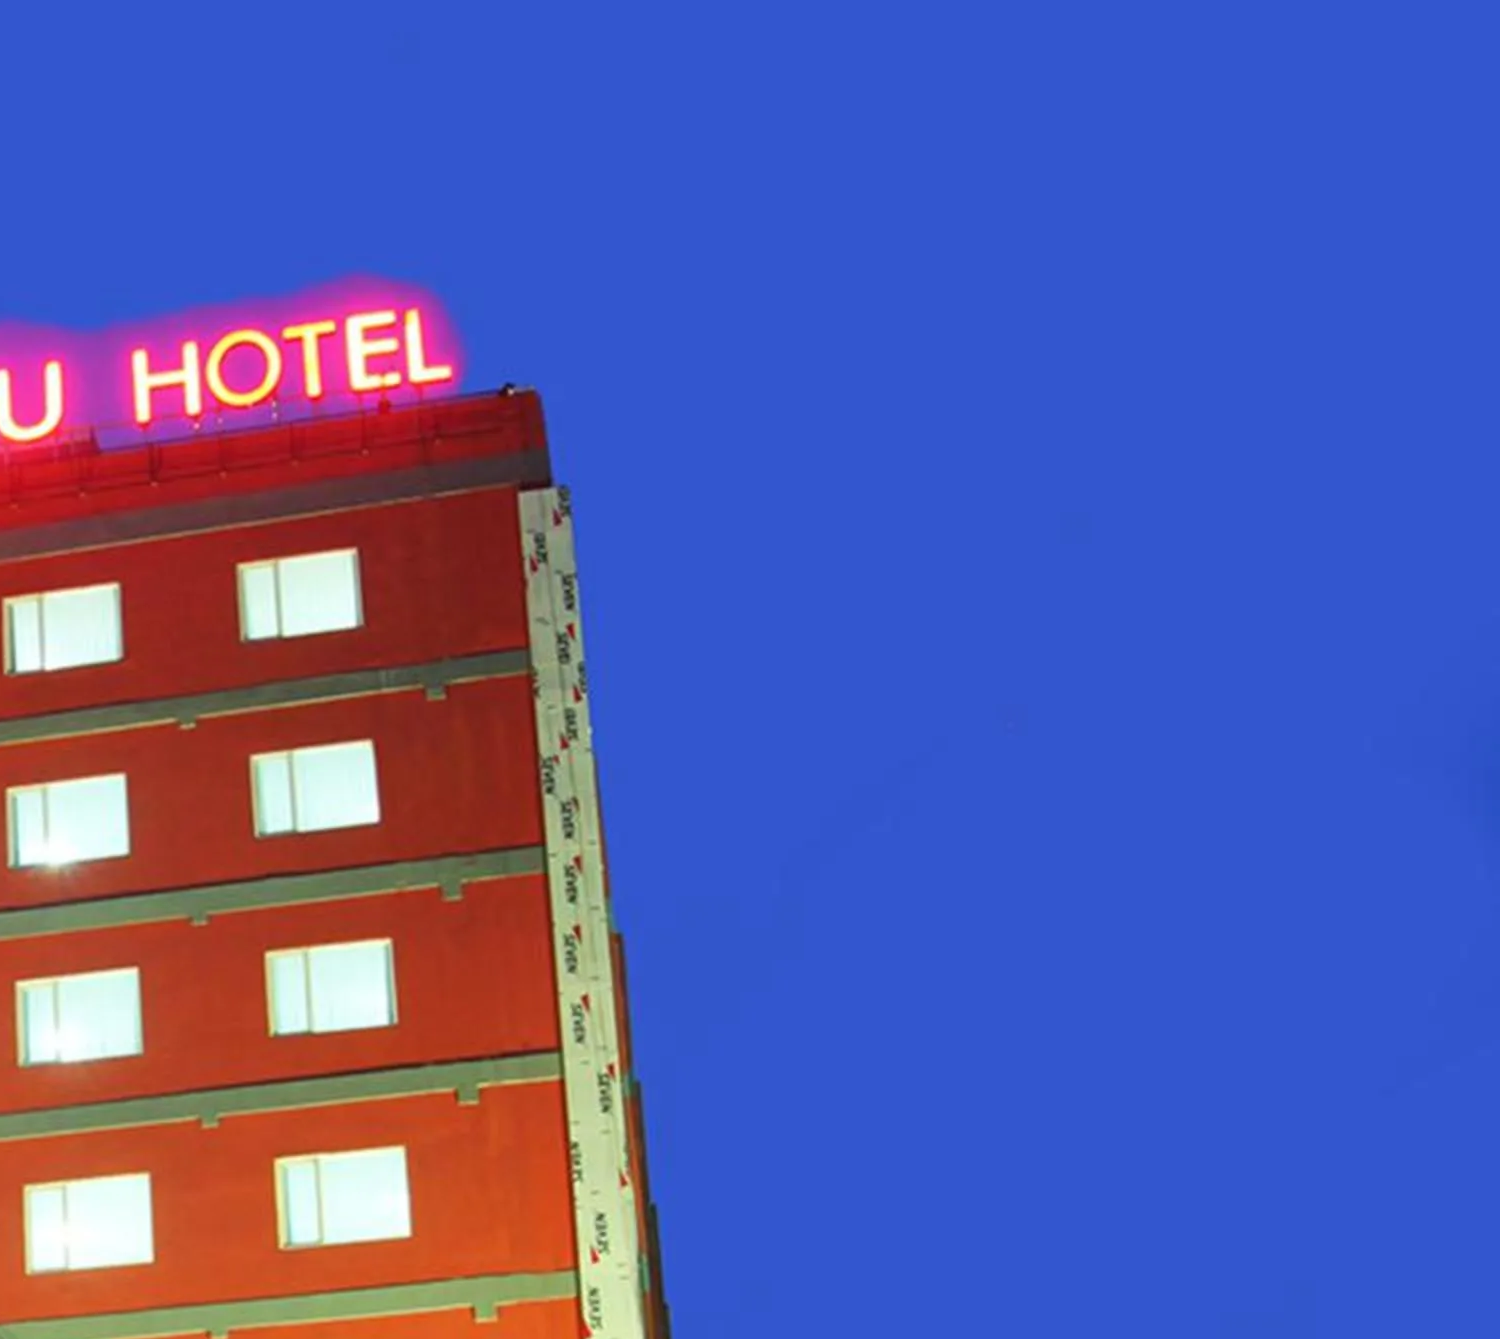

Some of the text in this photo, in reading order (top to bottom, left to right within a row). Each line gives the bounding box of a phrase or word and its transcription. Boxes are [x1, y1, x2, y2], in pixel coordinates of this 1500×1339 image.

[132, 308, 452, 424] HOTEL
[564, 865, 578, 903] SEVEN
[564, 934, 578, 973] SEVEN
[571, 1004, 586, 1044] SEVEN
[597, 1073, 612, 1113] SEVEN
[570, 1141, 583, 1182] SEVEN
[595, 1212, 610, 1254] SEVEN
[587, 1287, 603, 1329] SEVEN
